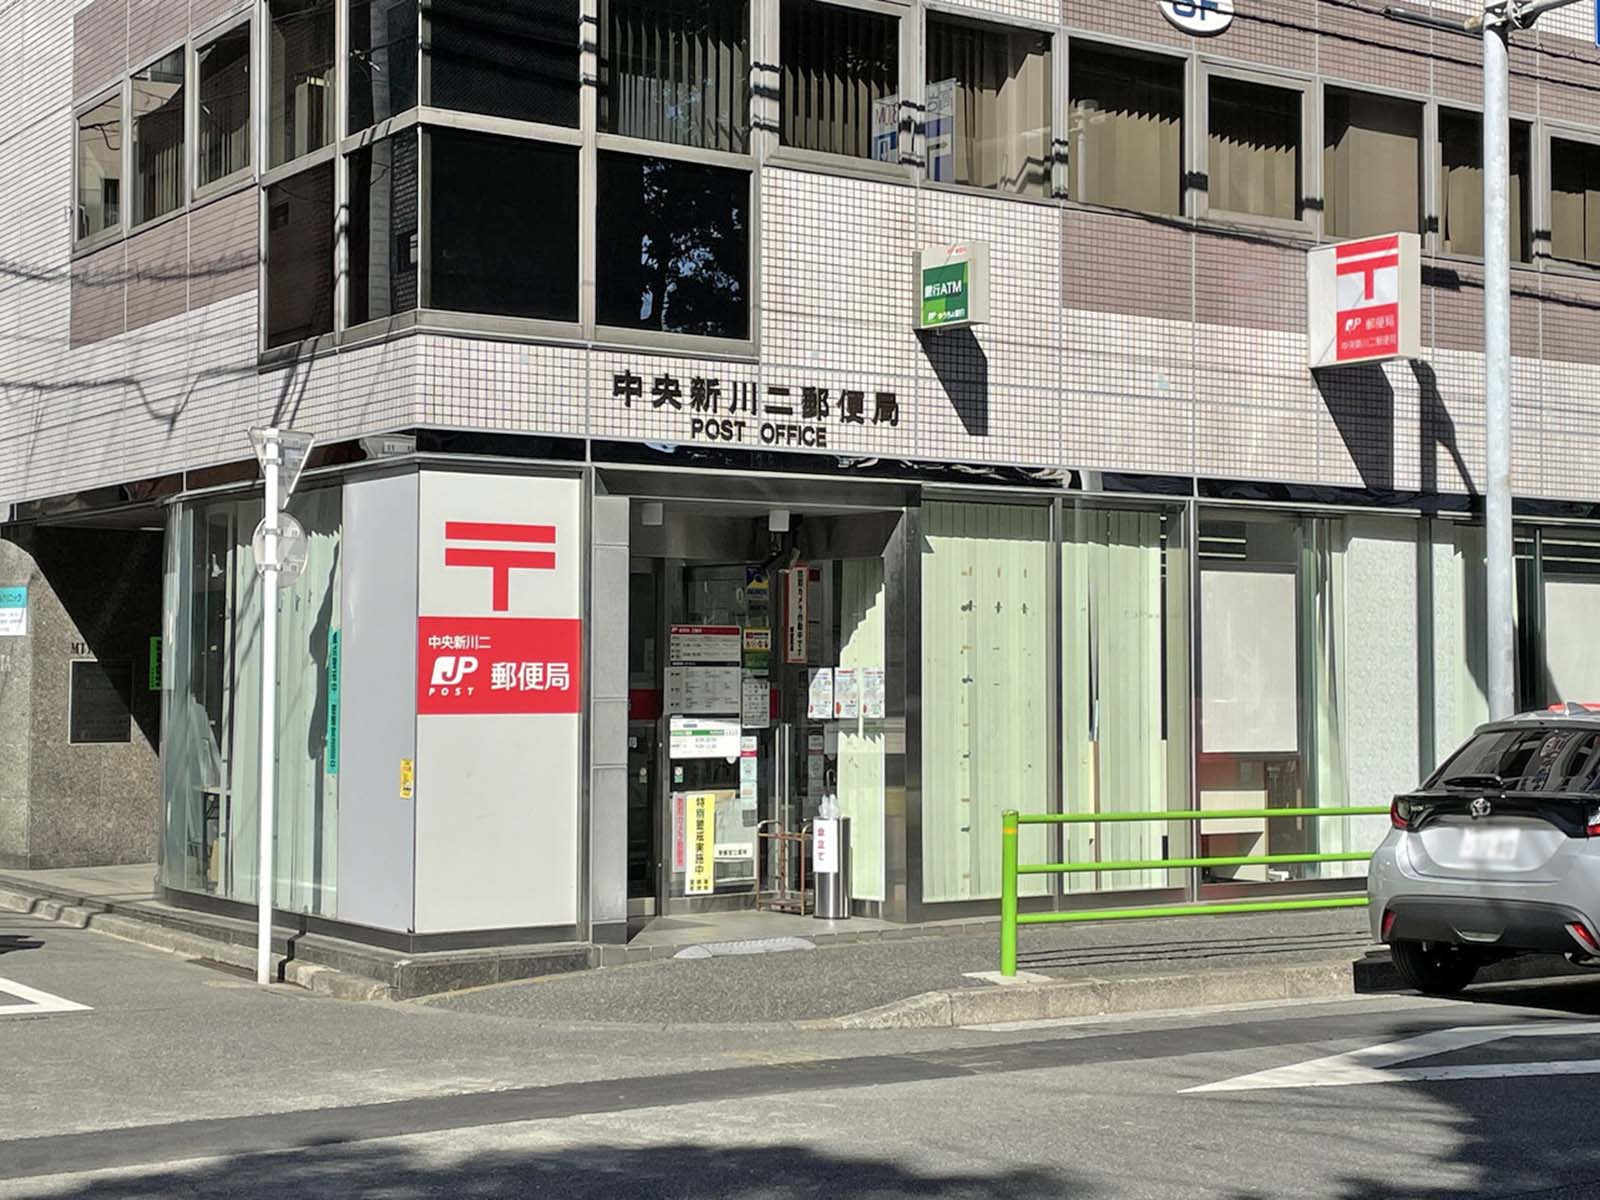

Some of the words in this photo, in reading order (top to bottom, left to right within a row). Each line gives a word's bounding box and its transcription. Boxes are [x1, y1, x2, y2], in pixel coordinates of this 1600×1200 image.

[612, 369, 900, 428] 中央新川二郵便局
[691, 421, 746, 443] POST
[761, 423, 827, 448] OFFICE
[428, 635, 492, 650] 中央新川二
[490, 661, 570, 692] 郵便局
[428, 687, 475, 696] POST
